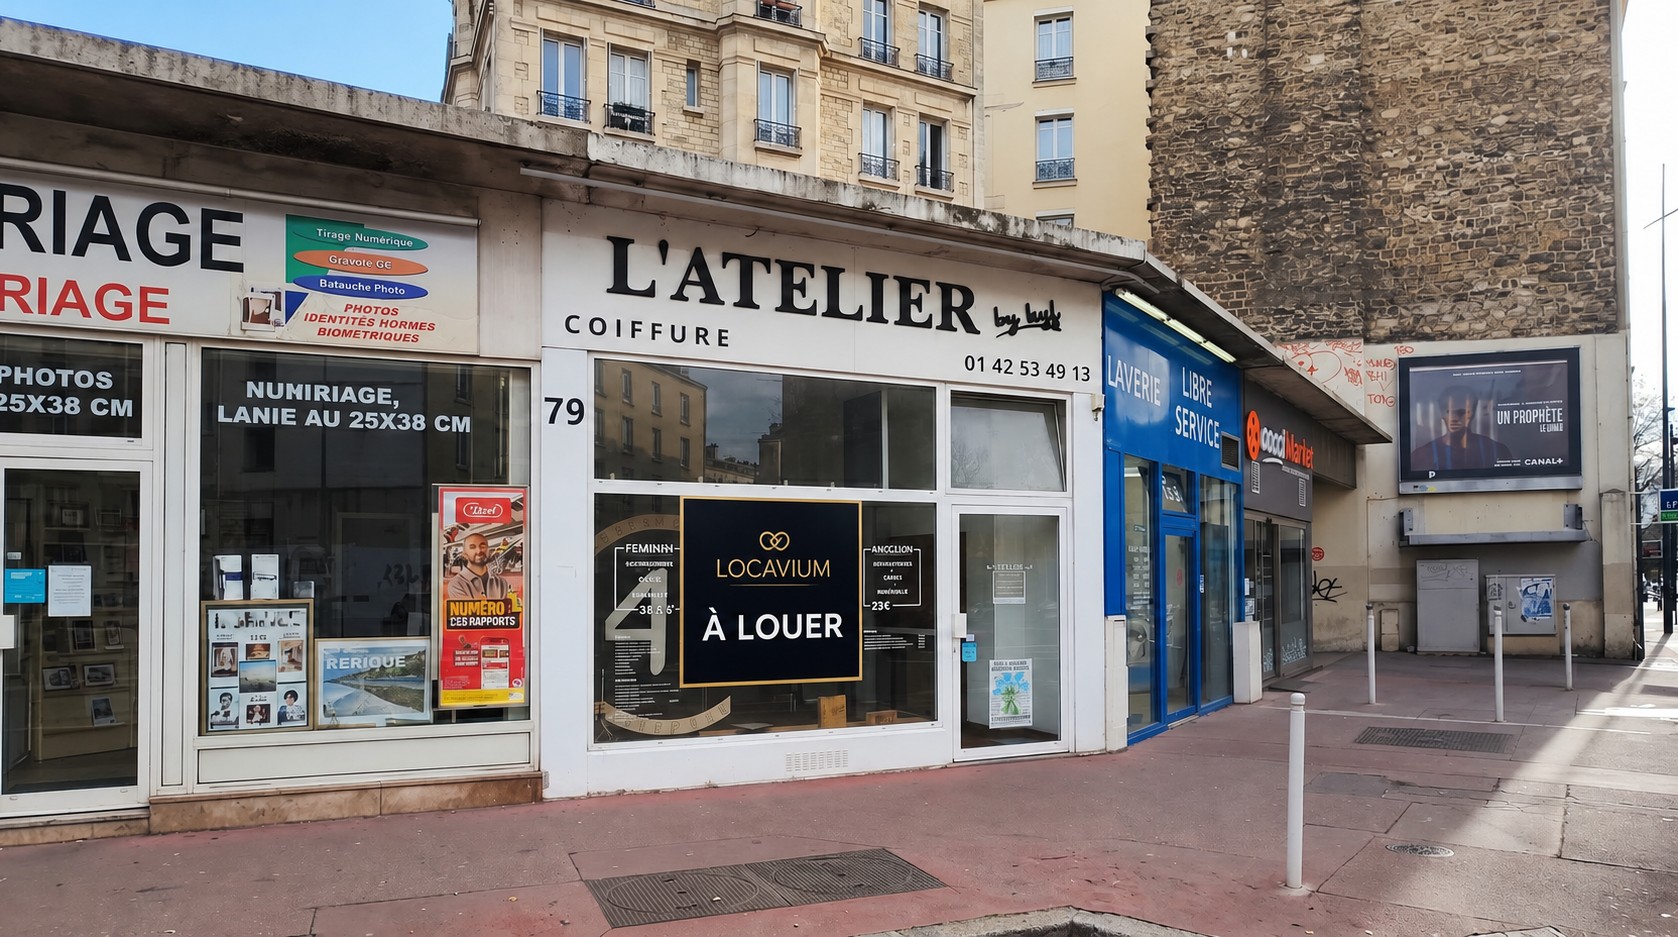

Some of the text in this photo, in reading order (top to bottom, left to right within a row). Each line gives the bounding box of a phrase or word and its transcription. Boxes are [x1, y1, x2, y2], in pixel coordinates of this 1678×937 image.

[0, 183, 244, 273] RIAGE
[317, 228, 414, 248] Tirage Numérique
[319, 279, 406, 295] Batauche Photo
[606, 235, 981, 335] L'ATELIER
[0, 274, 170, 325] RIAGE
[344, 303, 399, 317] PHOTOS
[317, 327, 420, 343] BIOMETRIQUES
[379, 318, 436, 331] HORMES
[564, 314, 730, 348] COIFFURE
[0, 365, 113, 390] PHOTOS
[964, 355, 1091, 382] 01 42 53 49 13
[1107, 355, 1161, 407] LAVERIE
[1182, 367, 1213, 409] LIBRE
[0, 393, 133, 417] 25X38 CM
[544, 396, 585, 426] 79
[1497, 405, 1563, 425] UN PROPHÈTE
[218, 405, 471, 433] LANIE AU 25X38 CM
[1175, 405, 1220, 449] SERVICE
[716, 558, 831, 578] LOCAVIUM
[871, 601, 891, 611] 23€
[469, 615, 516, 627] RAPPORTS
[702, 606, 727, 642] À
[738, 612, 844, 641] LOUER
